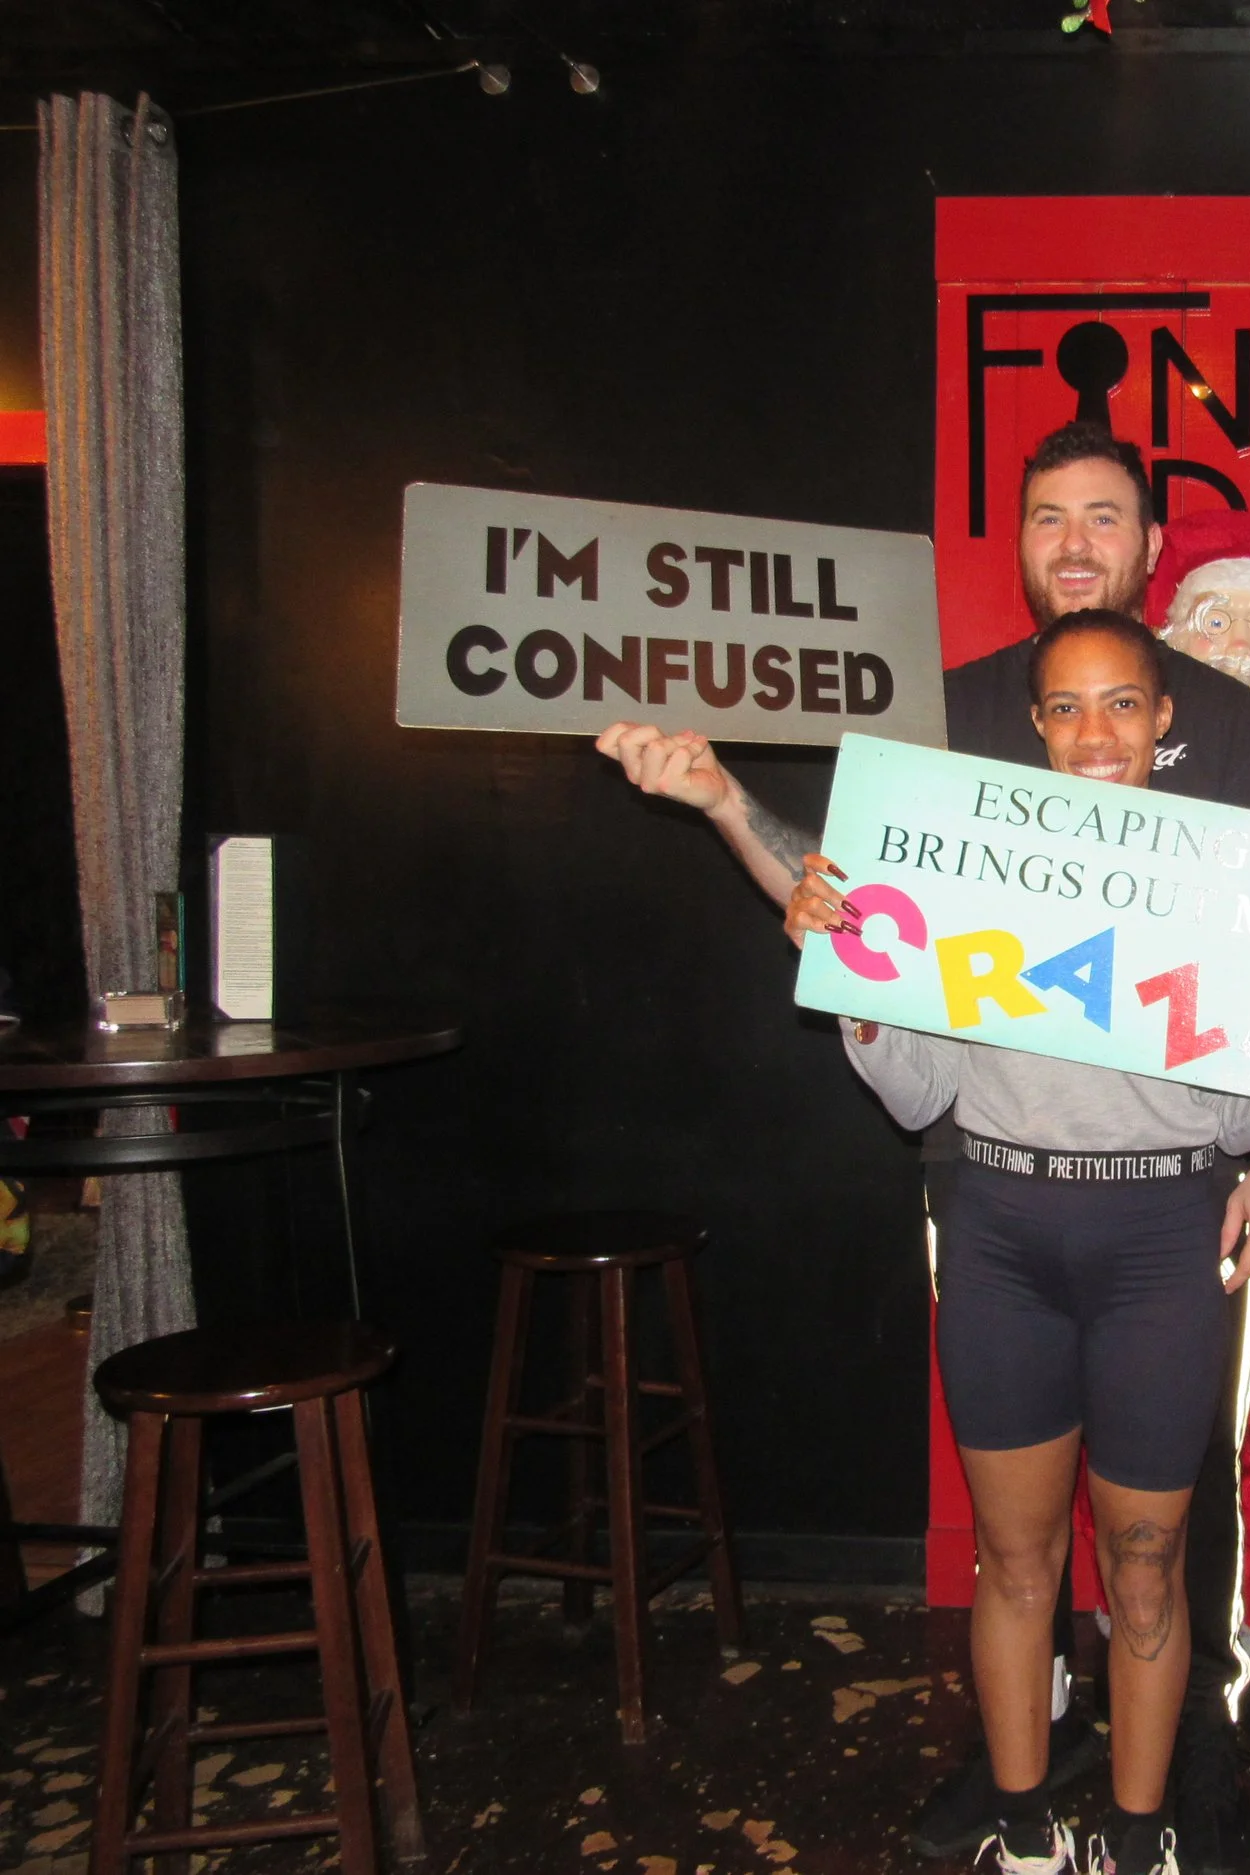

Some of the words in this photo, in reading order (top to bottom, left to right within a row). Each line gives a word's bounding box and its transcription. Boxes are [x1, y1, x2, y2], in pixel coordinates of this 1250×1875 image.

[485, 526, 600, 602] I'M
[645, 542, 859, 622] STILL
[446, 624, 895, 717] CONFUSED
[972, 779, 1250, 870] ESCAPING
[877, 823, 1086, 900] BRINGS
[1101, 870, 1219, 927] OUT
[1048, 1154, 1182, 1181] PRETTYLITTLETHING
